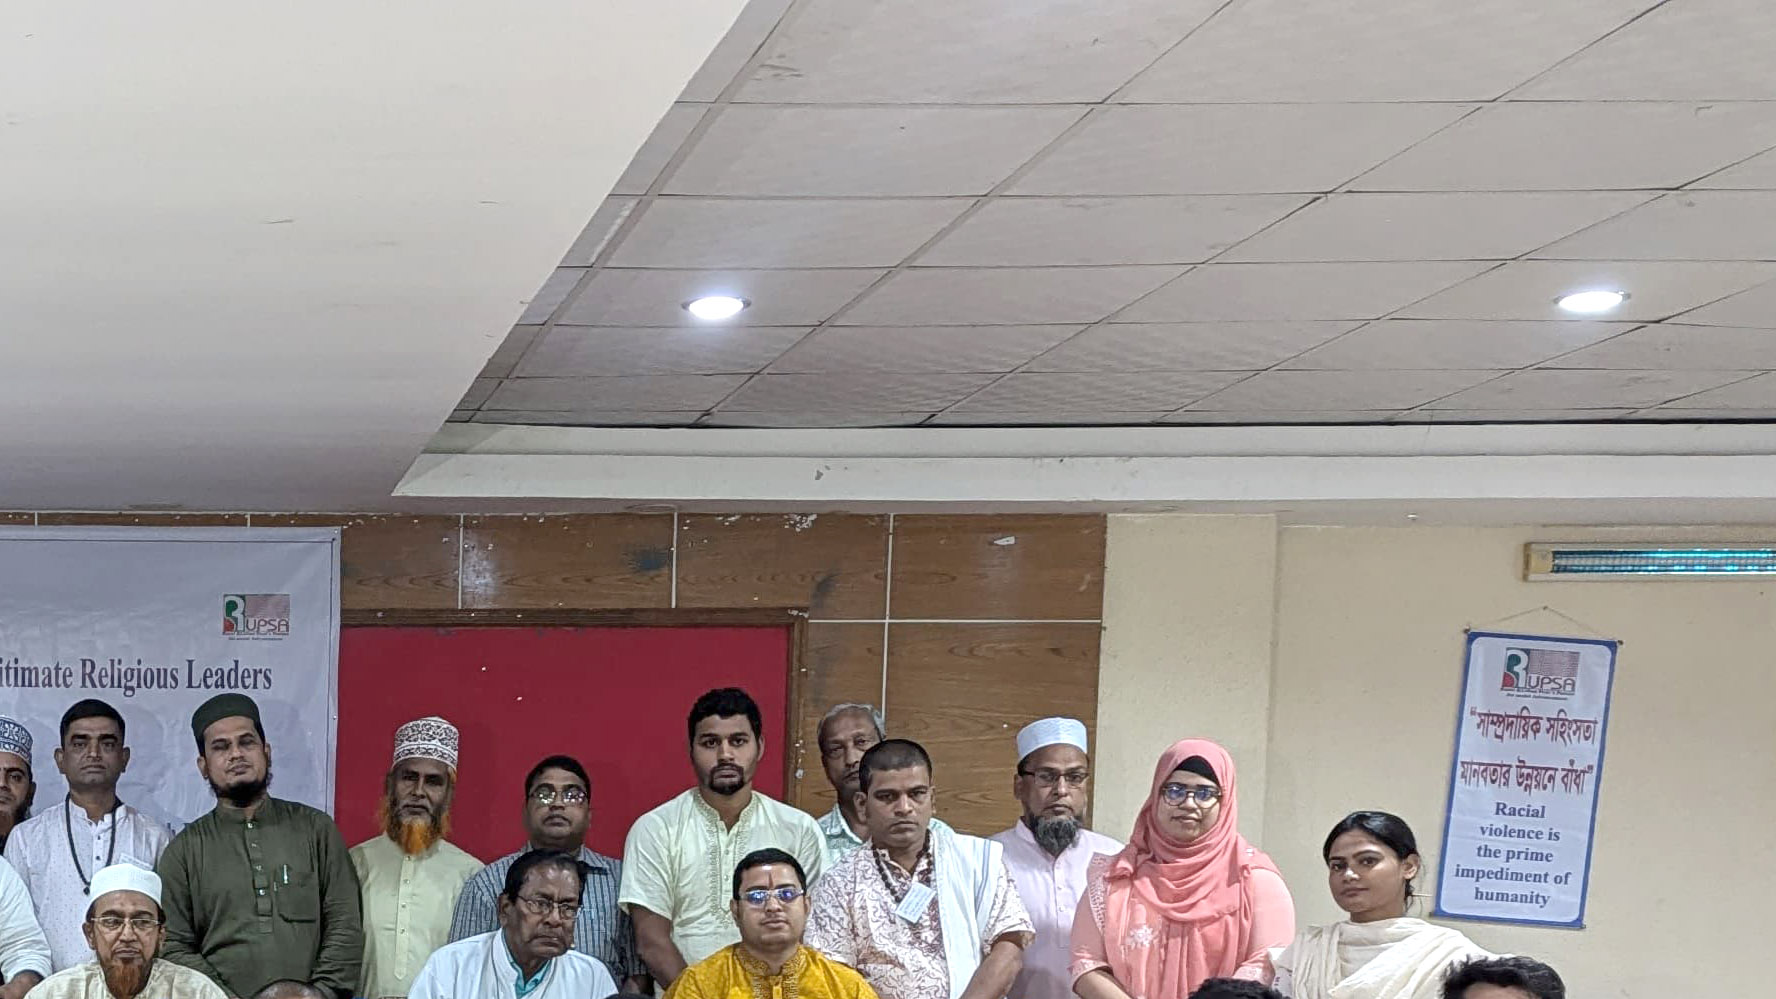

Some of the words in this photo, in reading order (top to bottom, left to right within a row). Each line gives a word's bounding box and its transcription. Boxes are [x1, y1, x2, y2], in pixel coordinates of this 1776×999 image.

[79, 657, 180, 697] Religious
[185, 658, 273, 691] Leaders
[1545, 708, 1598, 746] সহিংসতা
[1460, 759, 1513, 789] মানবতার
[1494, 801, 1547, 819] Racial
[1479, 823, 1544, 840] violence
[1547, 827, 1561, 842] is
[1476, 844, 1501, 859] the
[1505, 847, 1554, 863] prime
[1454, 863, 1550, 884] impediment
[1553, 871, 1572, 886] of
[1474, 886, 1551, 909] humanity
